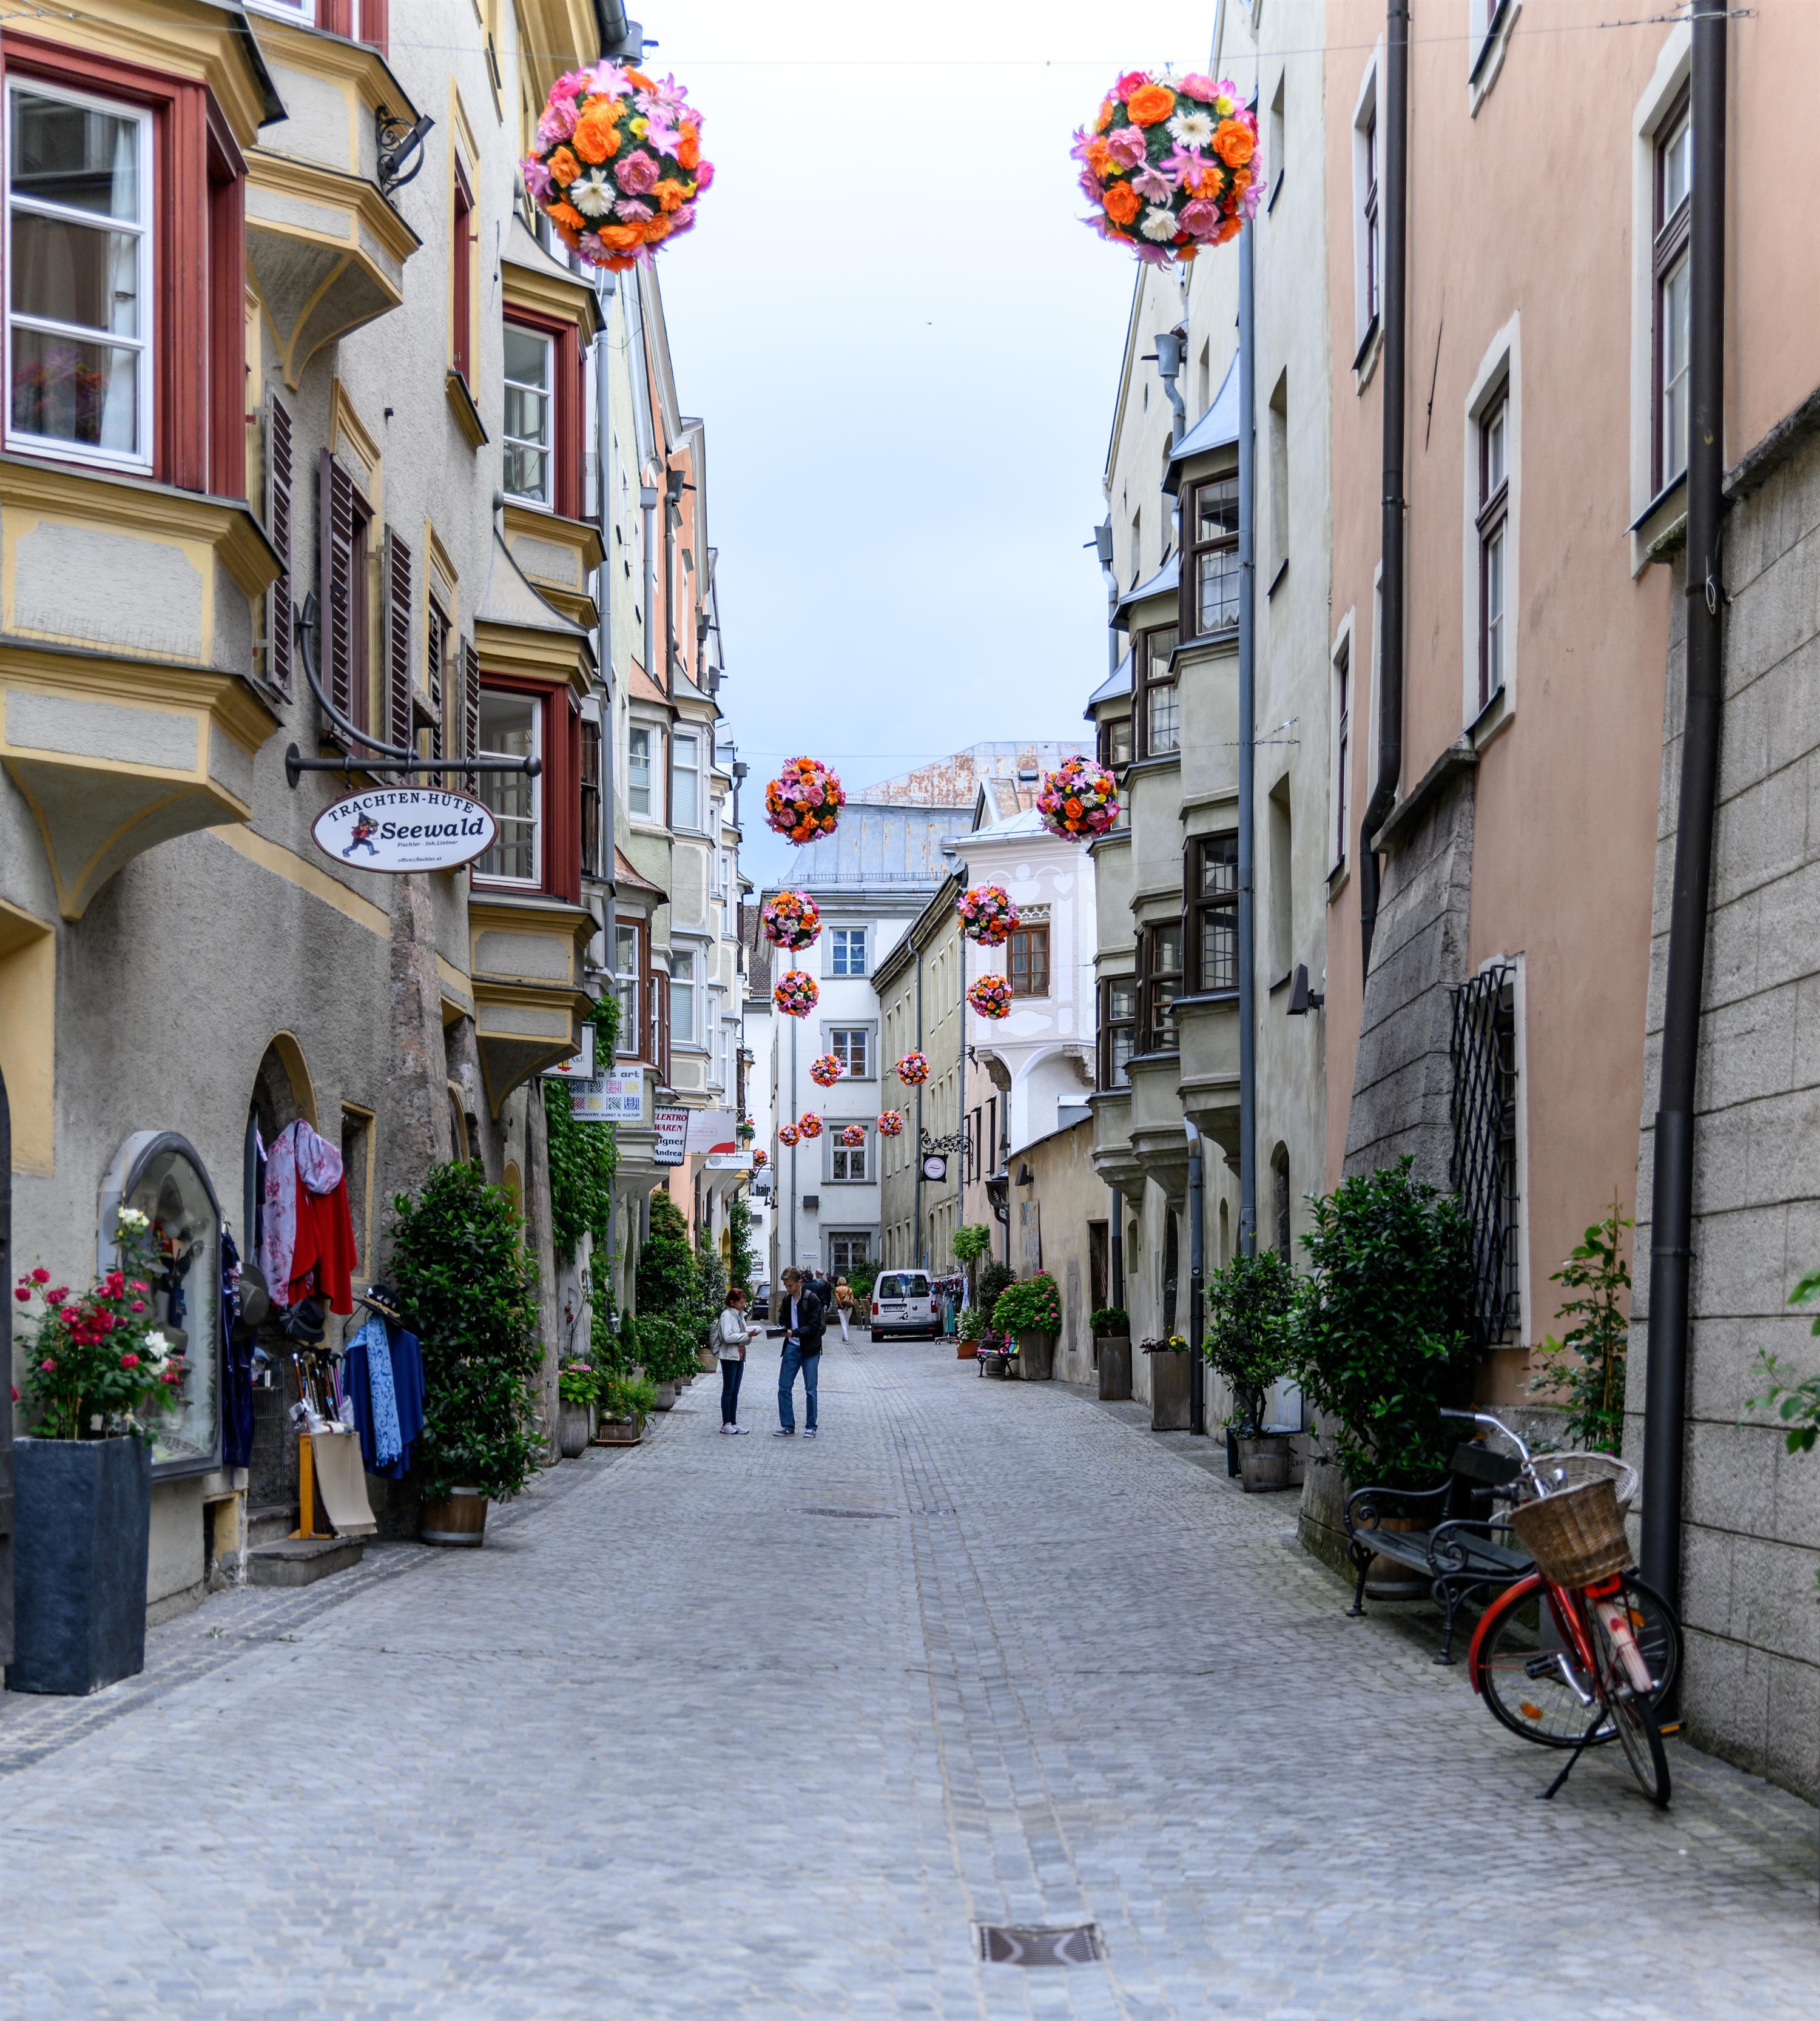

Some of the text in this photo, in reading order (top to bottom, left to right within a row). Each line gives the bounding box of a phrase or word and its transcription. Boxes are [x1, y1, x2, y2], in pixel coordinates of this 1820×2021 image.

[328, 792, 474, 822] TRACHTEN-HÜTE
[380, 817, 485, 840] Seewald
[572, 1097, 639, 1111] KUKU
[654, 1123, 682, 1132] WAREN
[756, 1184, 770, 1196] hair
